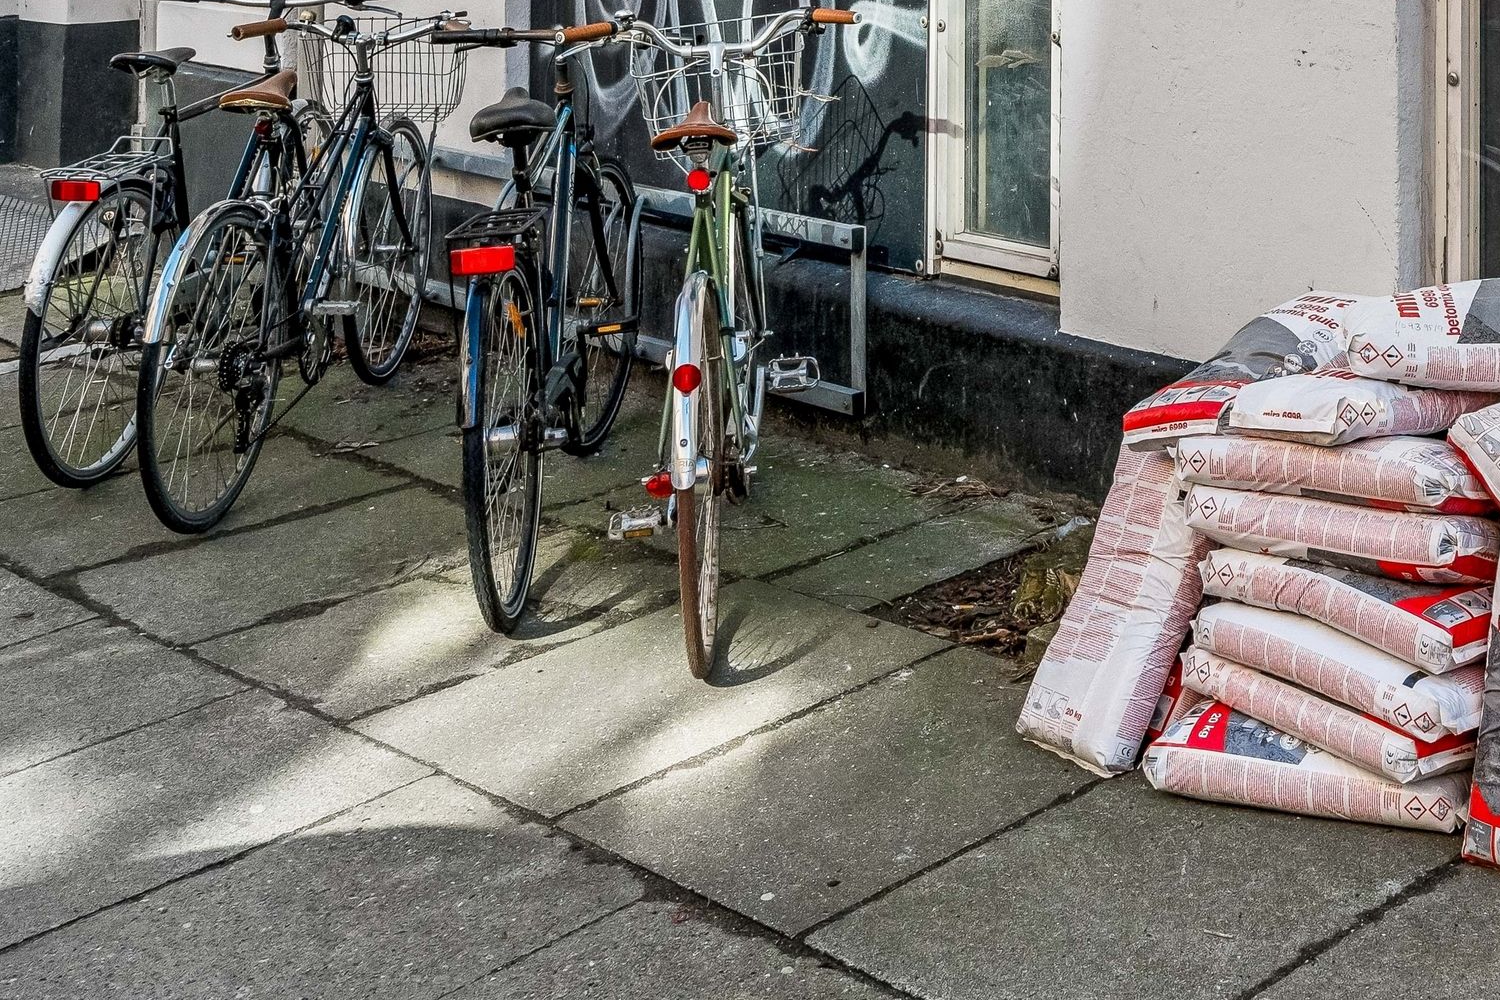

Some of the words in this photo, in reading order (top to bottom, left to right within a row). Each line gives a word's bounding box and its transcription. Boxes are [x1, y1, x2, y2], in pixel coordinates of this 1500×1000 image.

[1065, 708, 1074, 717] 20
[1074, 711, 1082, 722] kg
[1208, 713, 1222, 724] 20
[1198, 725, 1215, 739] kg
